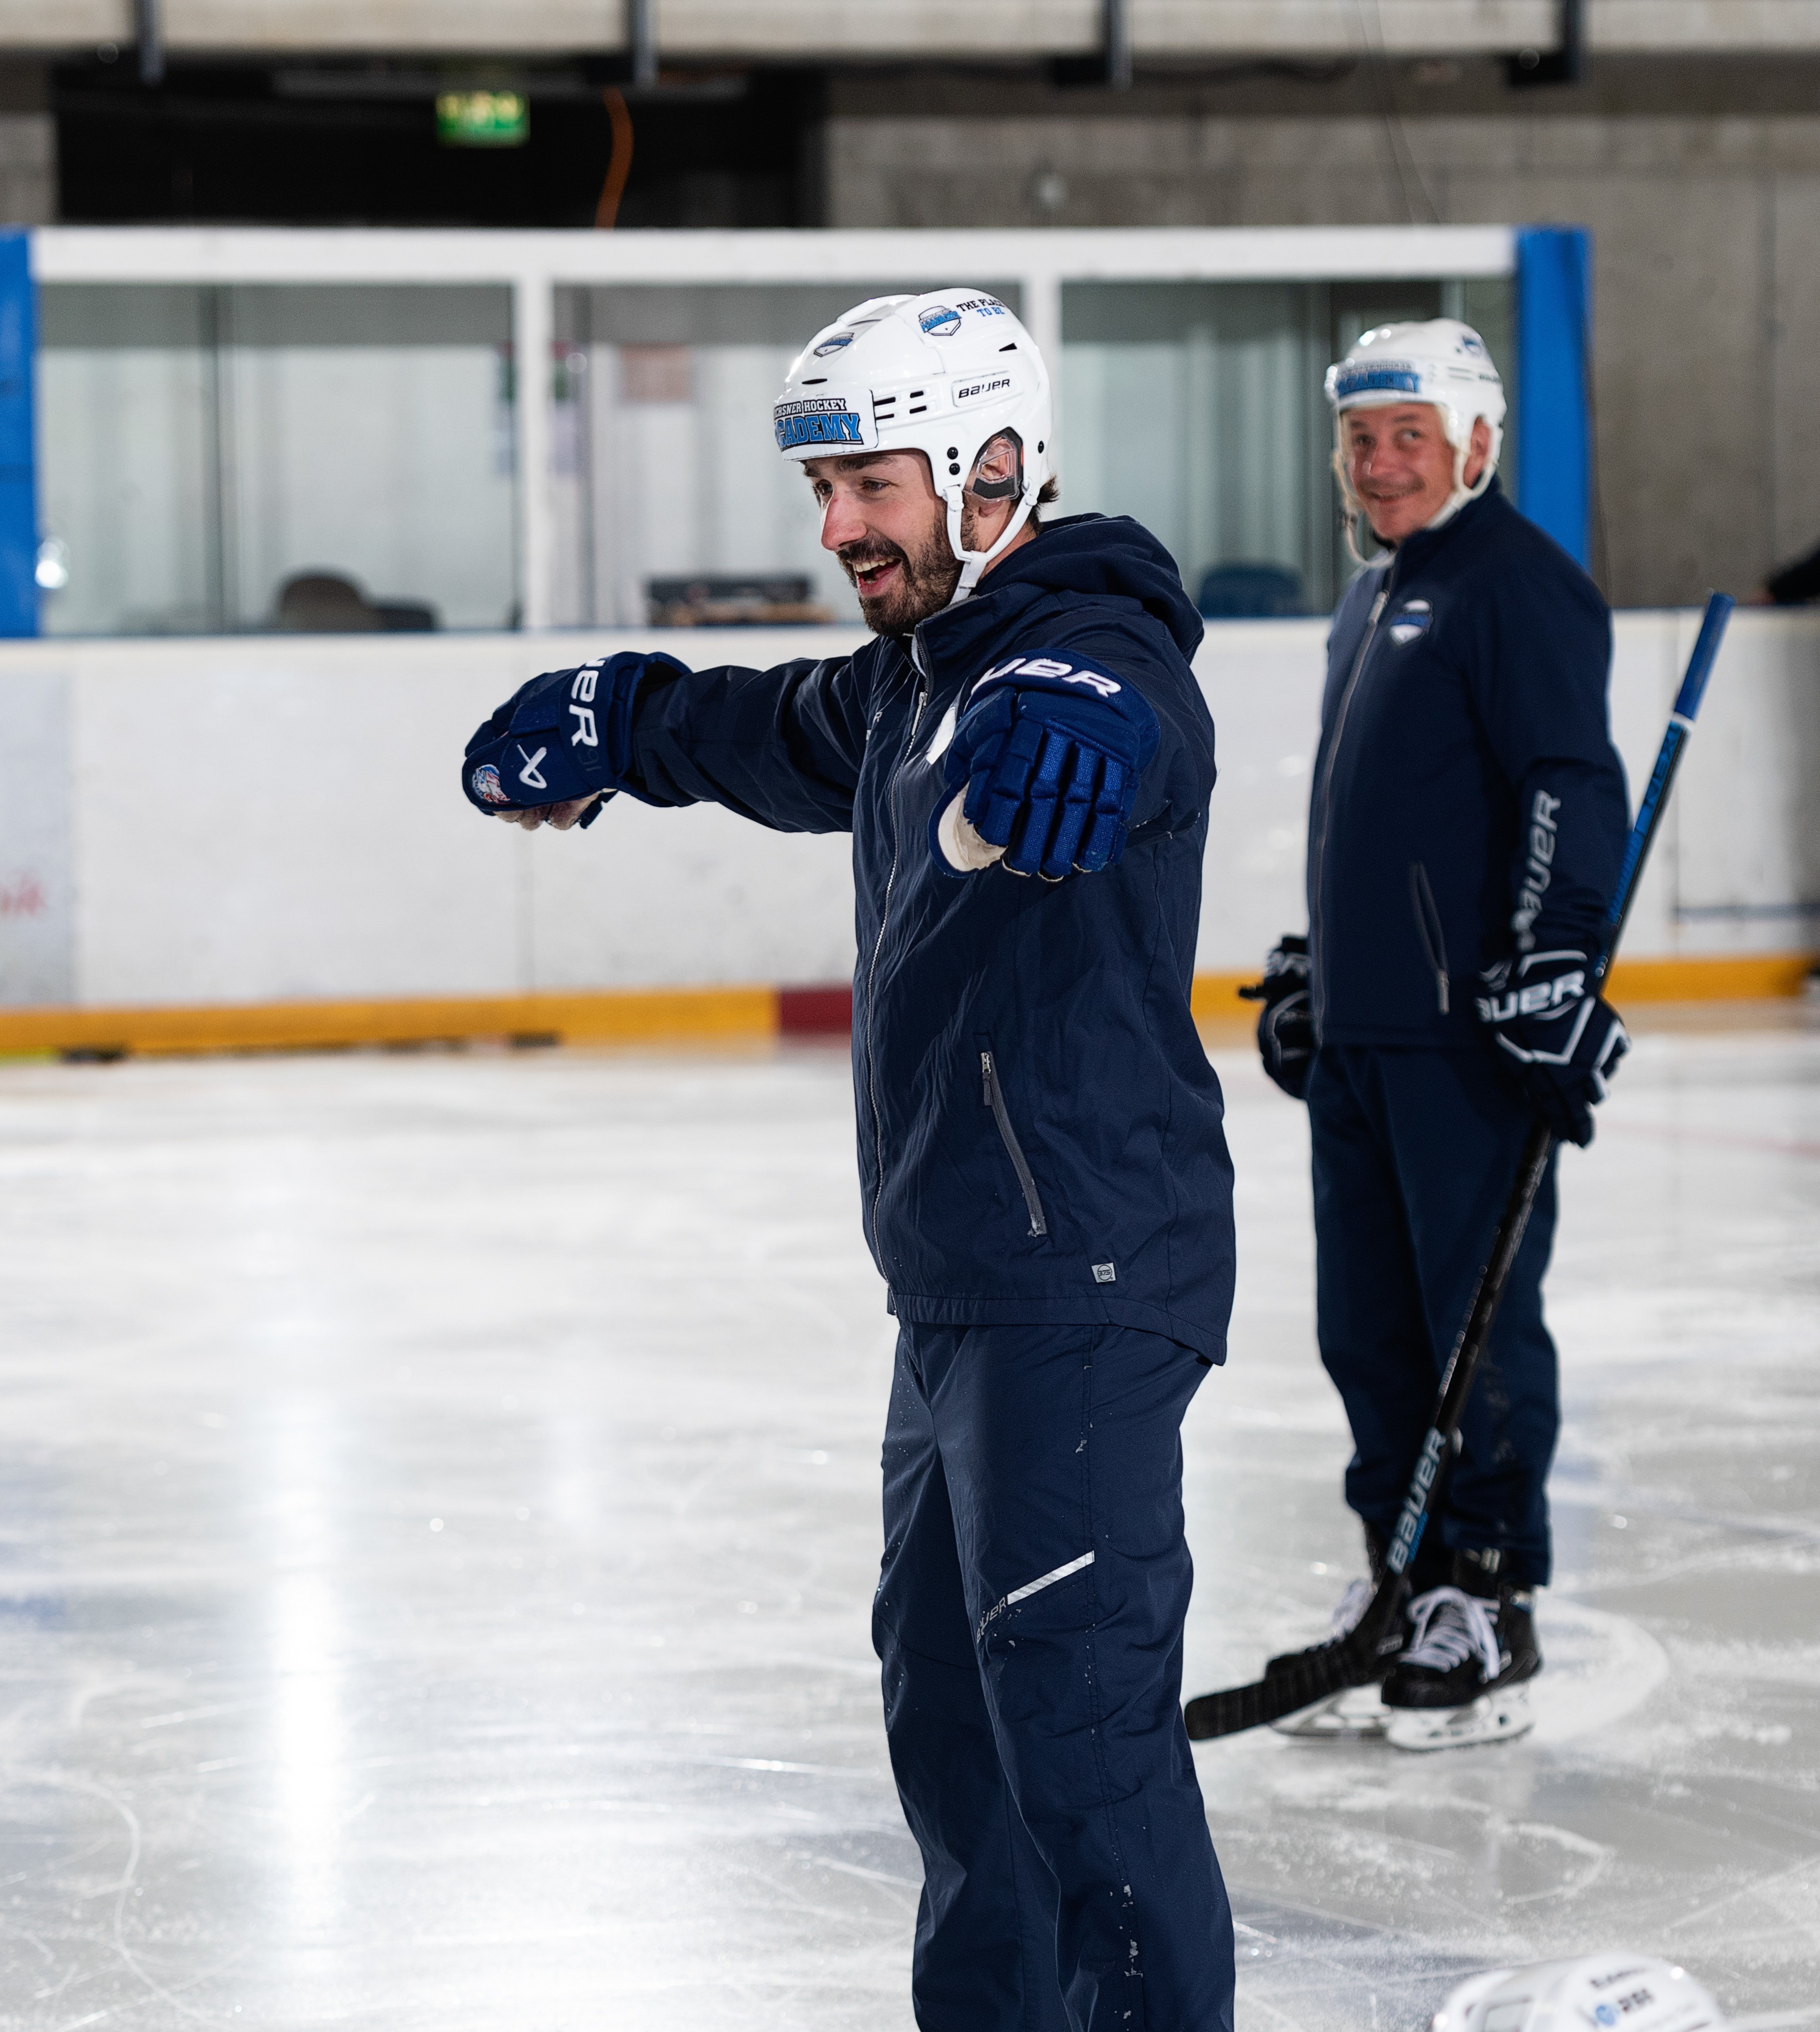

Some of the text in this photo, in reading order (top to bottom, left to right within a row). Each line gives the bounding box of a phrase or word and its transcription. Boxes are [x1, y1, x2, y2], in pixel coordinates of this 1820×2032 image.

[956, 301, 980, 311] THE
[977, 308, 992, 317] TO
[958, 379, 1010, 399] BAUER
[774, 399, 846, 419] CHSNER HOCKEY
[775, 414, 862, 448] CADEMY
[1388, 1427, 1446, 1575] BAUER
